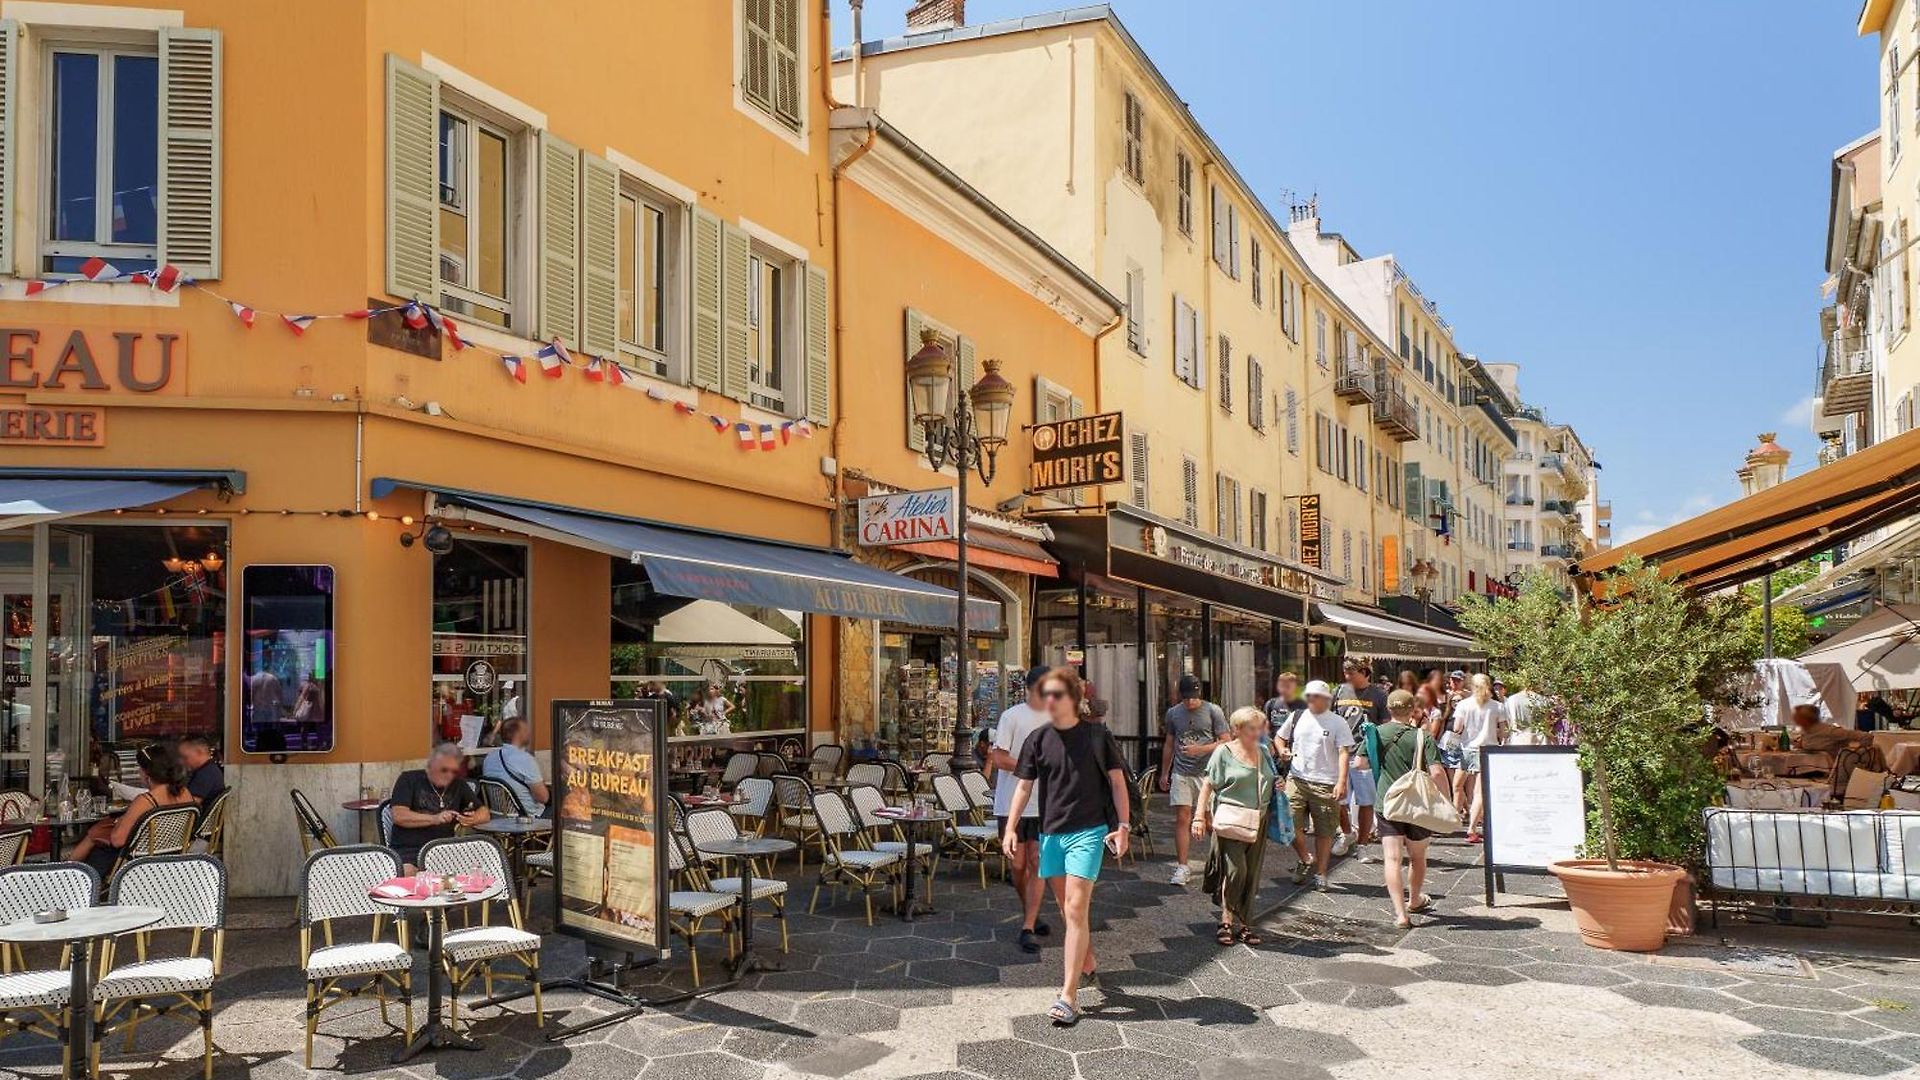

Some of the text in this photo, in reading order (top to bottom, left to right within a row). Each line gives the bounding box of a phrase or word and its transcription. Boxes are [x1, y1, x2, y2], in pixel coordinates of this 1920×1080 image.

[0, 329, 179, 392] EAU
[0, 409, 97, 440] ERIE
[1063, 415, 1120, 447] CHEZ
[1033, 451, 1120, 487] MORI'S
[890, 494, 947, 519] Atelier
[863, 516, 950, 542] CARINA
[1302, 497, 1319, 567] HEZ MORI'S
[816, 588, 838, 609] AU
[841, 589, 912, 617] BUREAU
[5, 675, 18, 683] AU
[568, 745, 651, 773] BREAKFAST
[567, 769, 649, 798] AU BUREAU
